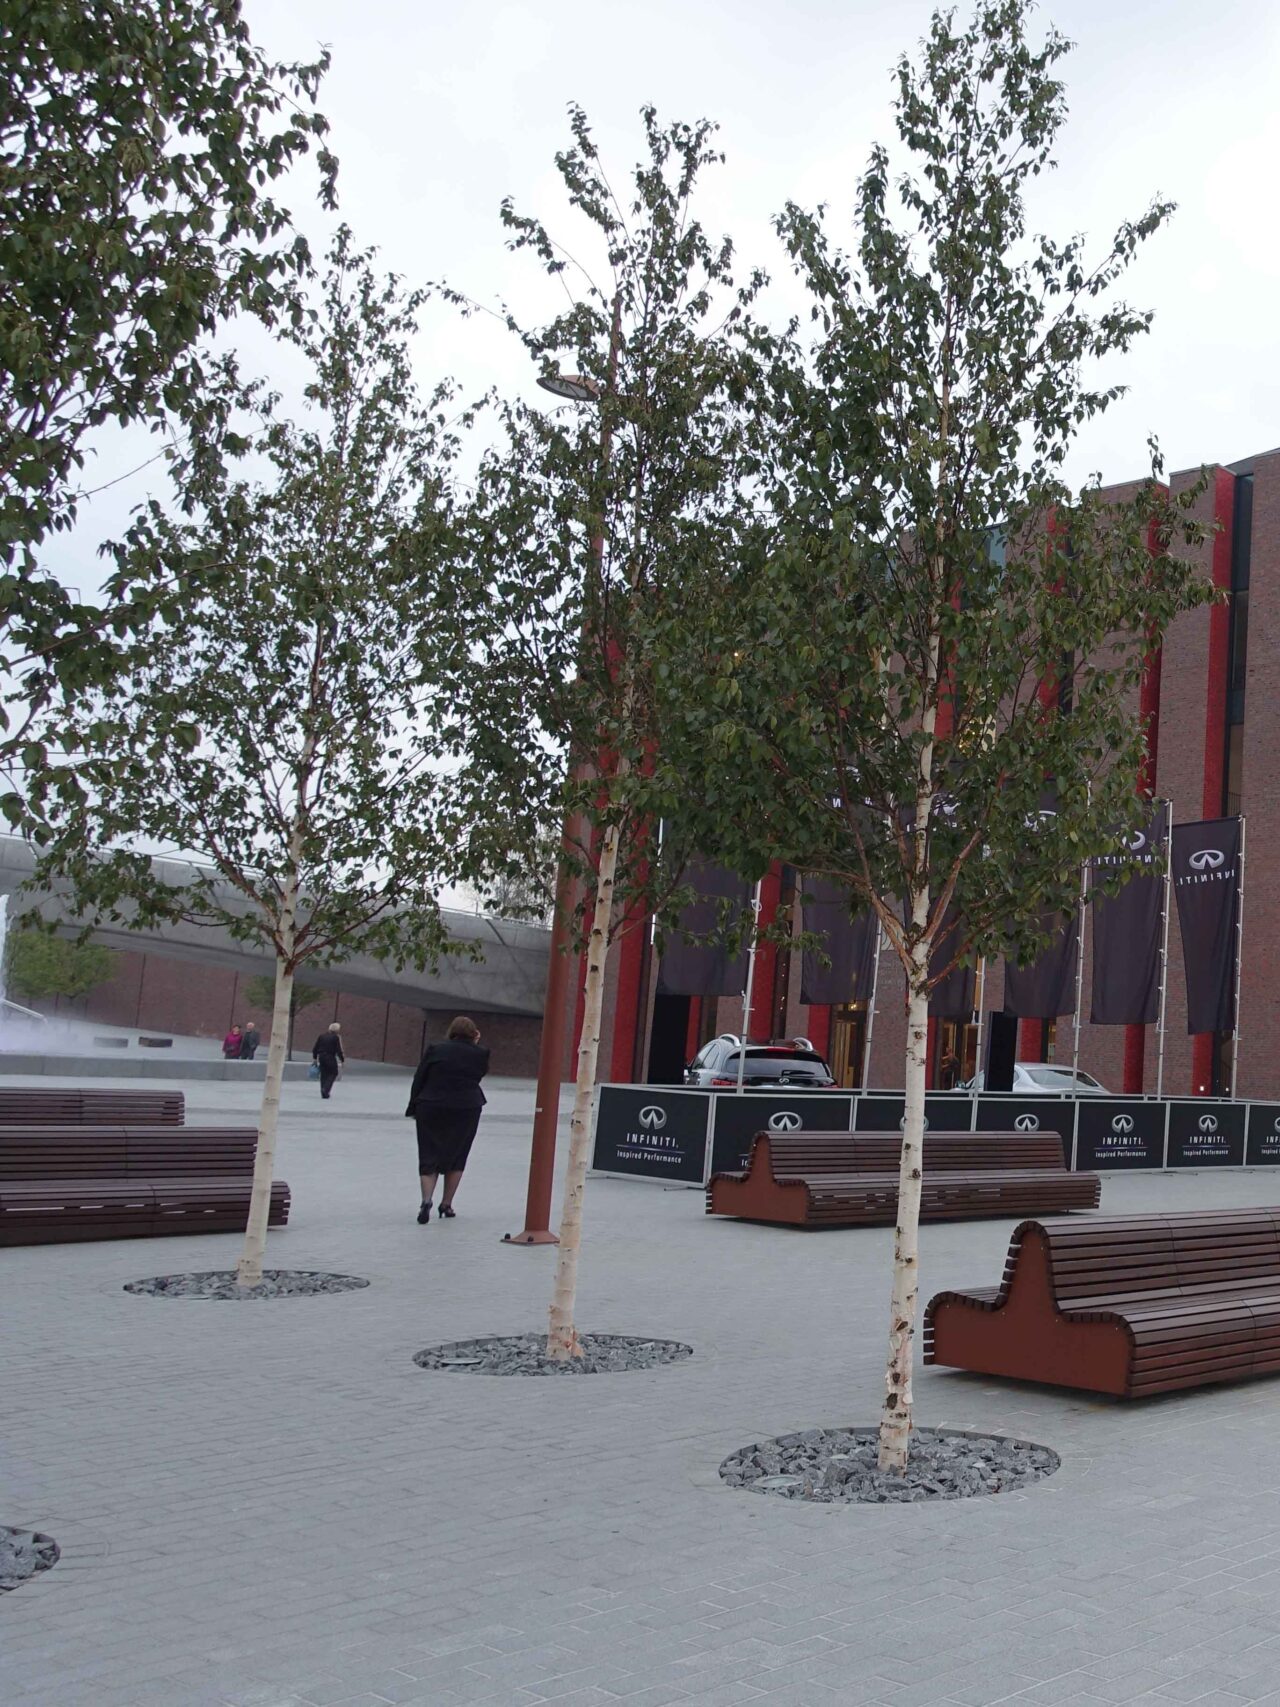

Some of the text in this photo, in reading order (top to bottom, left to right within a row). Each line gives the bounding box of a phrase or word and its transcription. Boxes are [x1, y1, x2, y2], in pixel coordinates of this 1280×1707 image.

[626, 1132, 676, 1148] INFINITI
[1102, 1136, 1142, 1145] INFINITI
[616, 1150, 682, 1164] Inspired Performance
